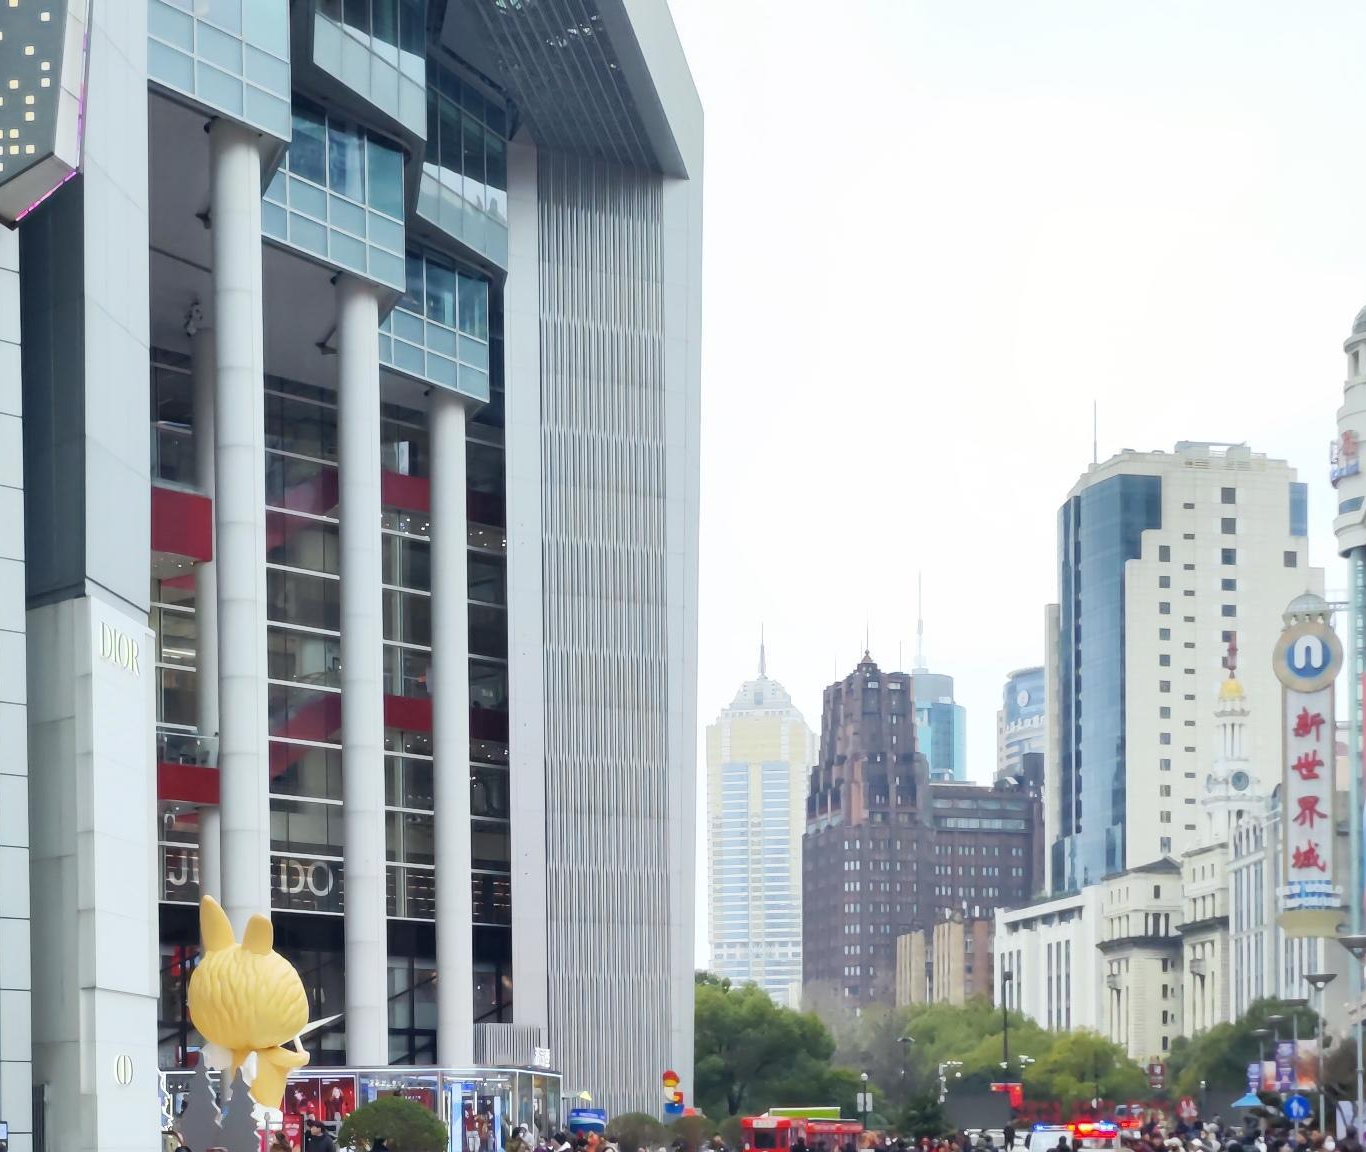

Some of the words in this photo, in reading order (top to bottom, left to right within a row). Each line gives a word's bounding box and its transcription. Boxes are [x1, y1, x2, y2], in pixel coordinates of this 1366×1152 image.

[99, 620, 140, 677] DIOR
[1291, 706, 1328, 872] 新世界城
